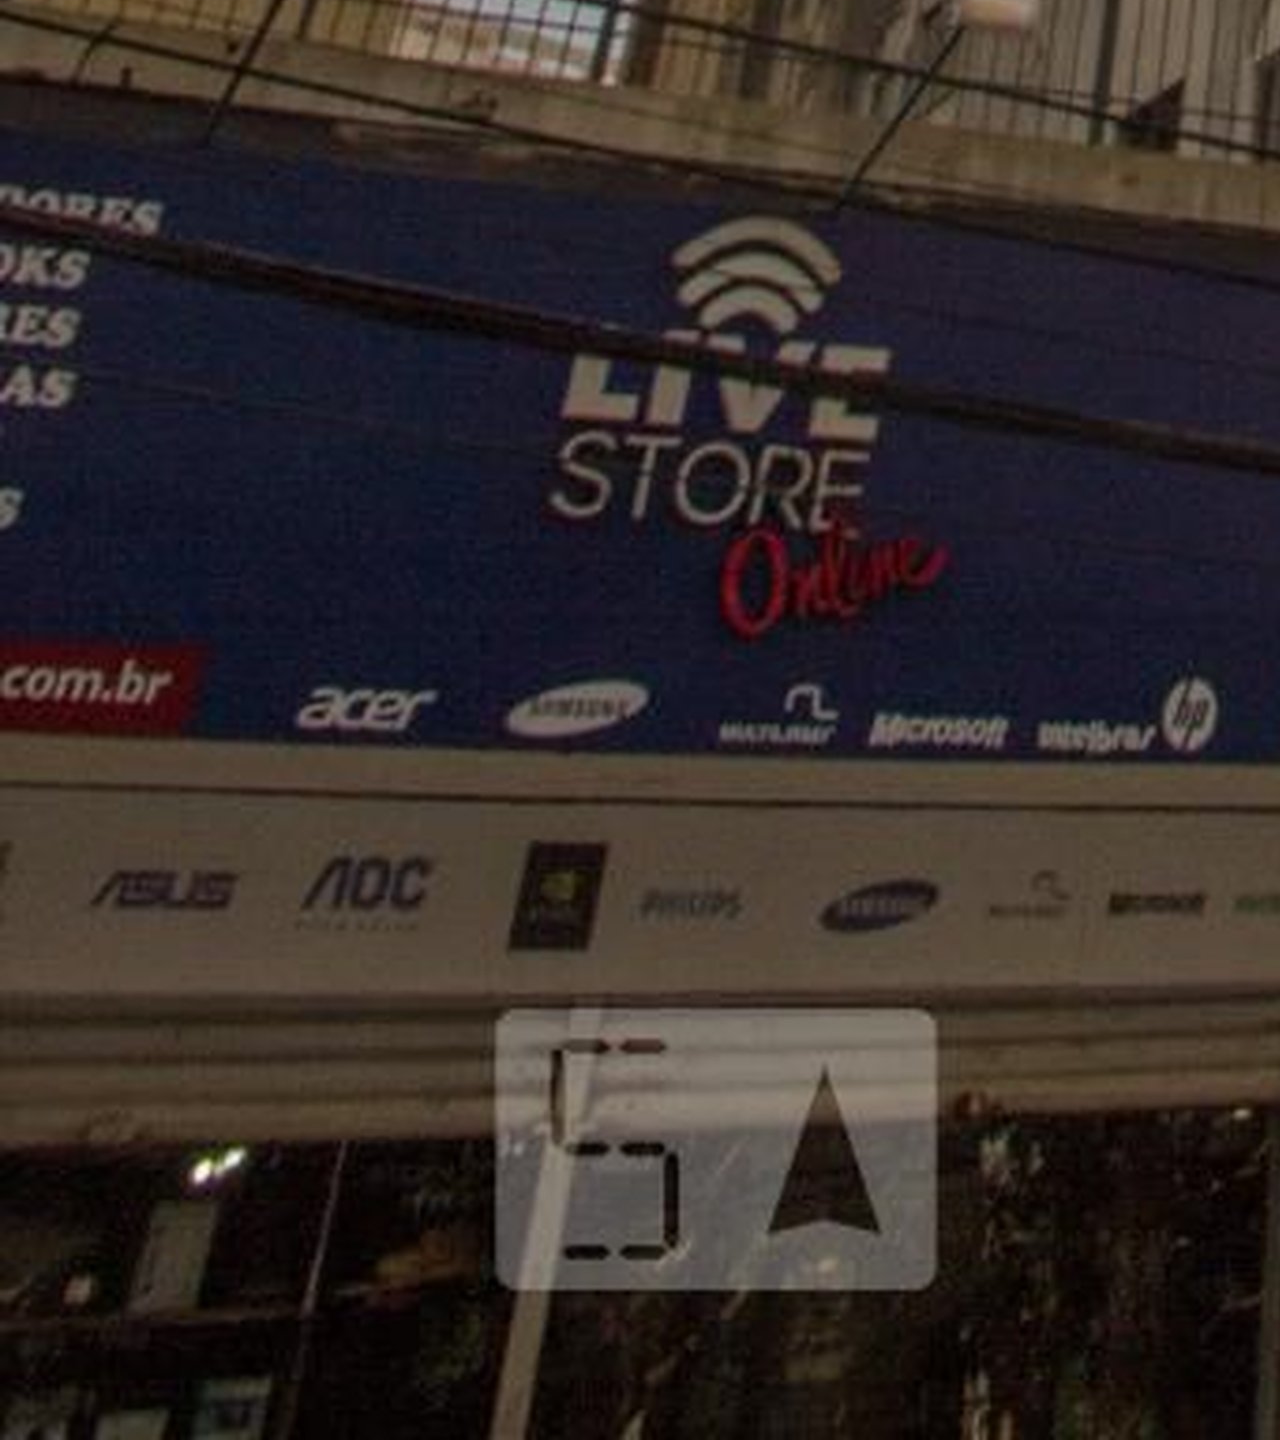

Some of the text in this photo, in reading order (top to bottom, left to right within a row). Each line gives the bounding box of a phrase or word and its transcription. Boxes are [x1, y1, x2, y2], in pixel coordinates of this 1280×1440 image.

[561, 325, 892, 442] LIVE
[549, 430, 872, 540] STORE
[719, 525, 953, 642] Online
[296, 685, 439, 732] acer
[90, 869, 240, 912] ASUS
[300, 855, 433, 913] AOC
